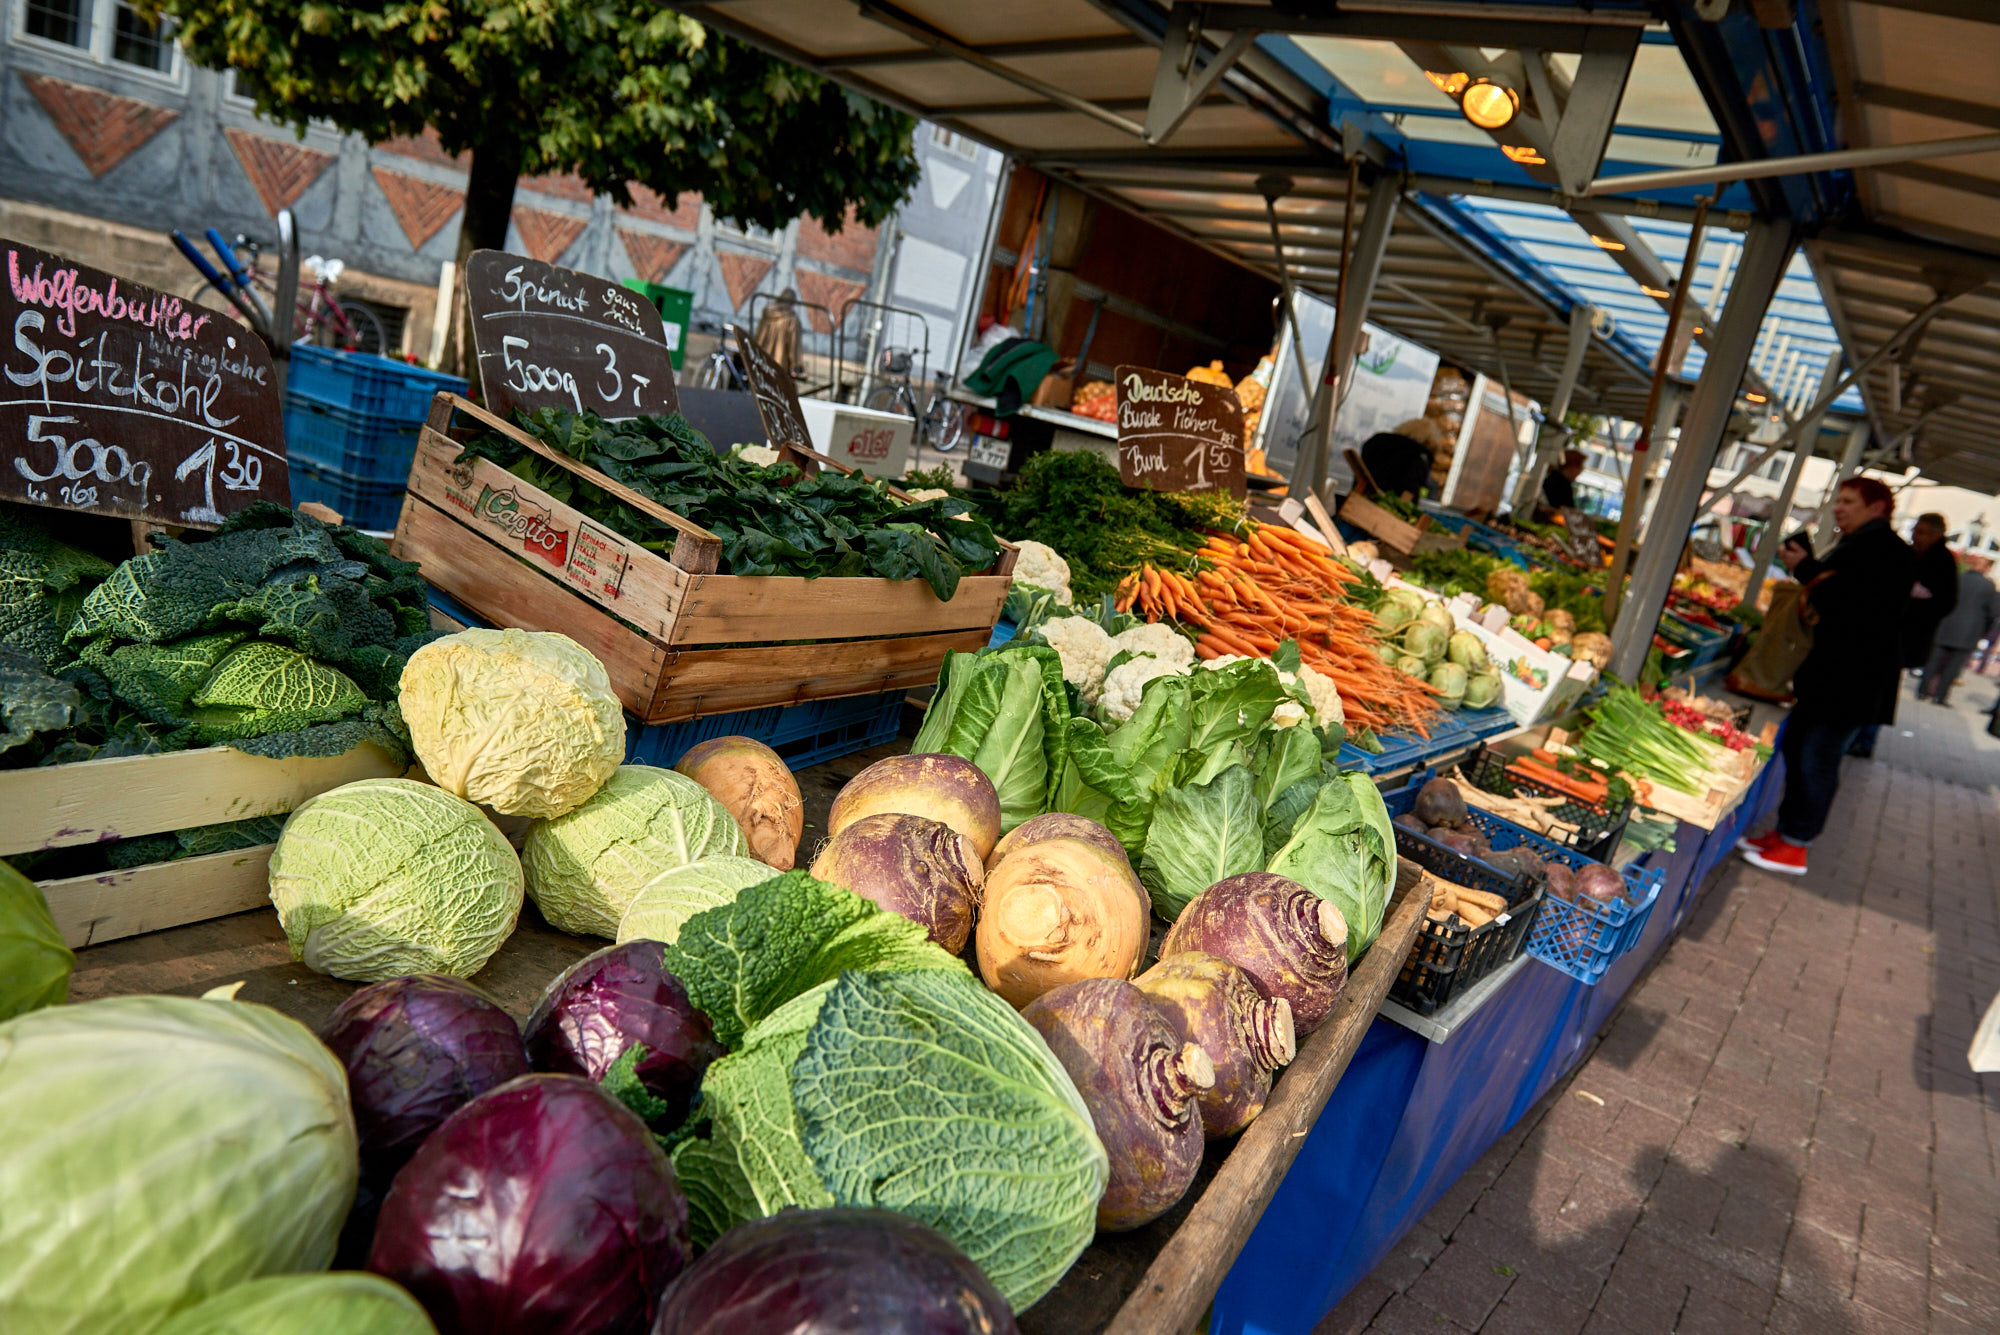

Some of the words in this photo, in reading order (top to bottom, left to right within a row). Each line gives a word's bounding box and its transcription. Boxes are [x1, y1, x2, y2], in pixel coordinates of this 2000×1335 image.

[1123, 373, 1204, 406] Deutsche
[14, 415, 152, 509] 500g
[1127, 444, 1169, 477] Bund
[484, 488, 562, 552] Capito
